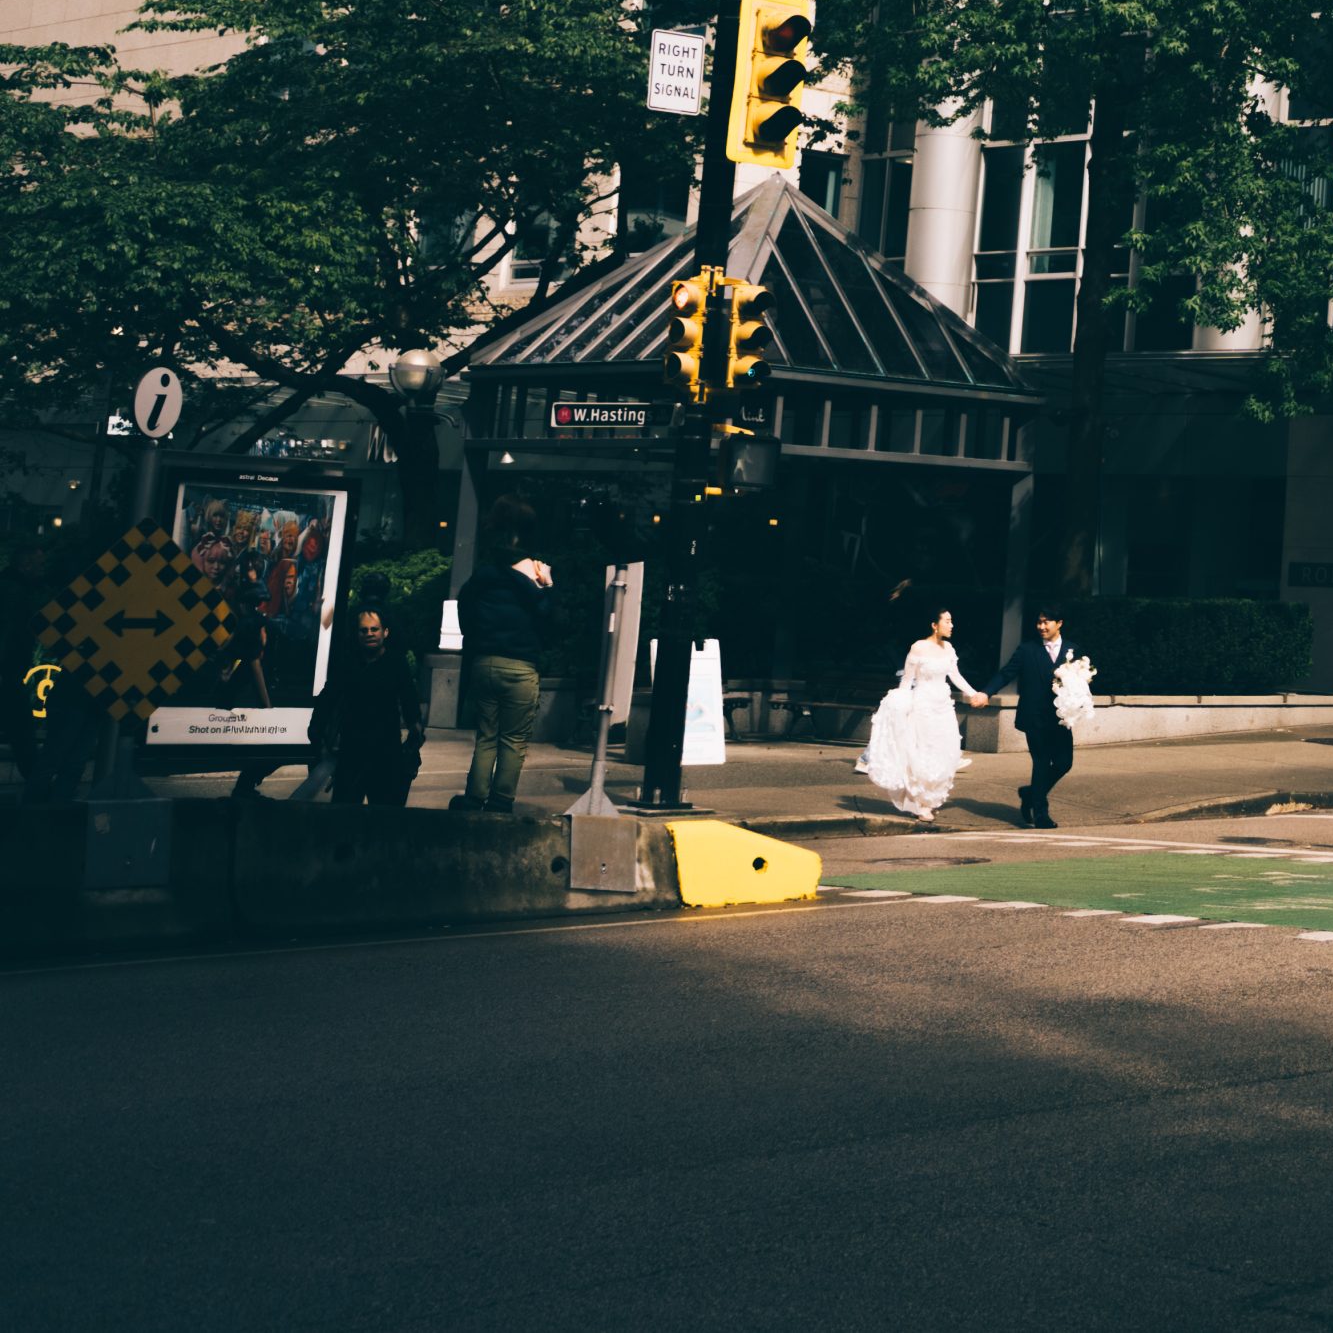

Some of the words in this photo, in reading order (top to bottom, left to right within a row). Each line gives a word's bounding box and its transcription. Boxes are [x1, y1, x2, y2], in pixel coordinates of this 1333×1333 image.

[658, 42, 698, 59] RIGHT
[660, 63, 695, 79] TURN
[654, 82, 696, 100] SIGNAL
[188, 725, 210, 734] Shot
